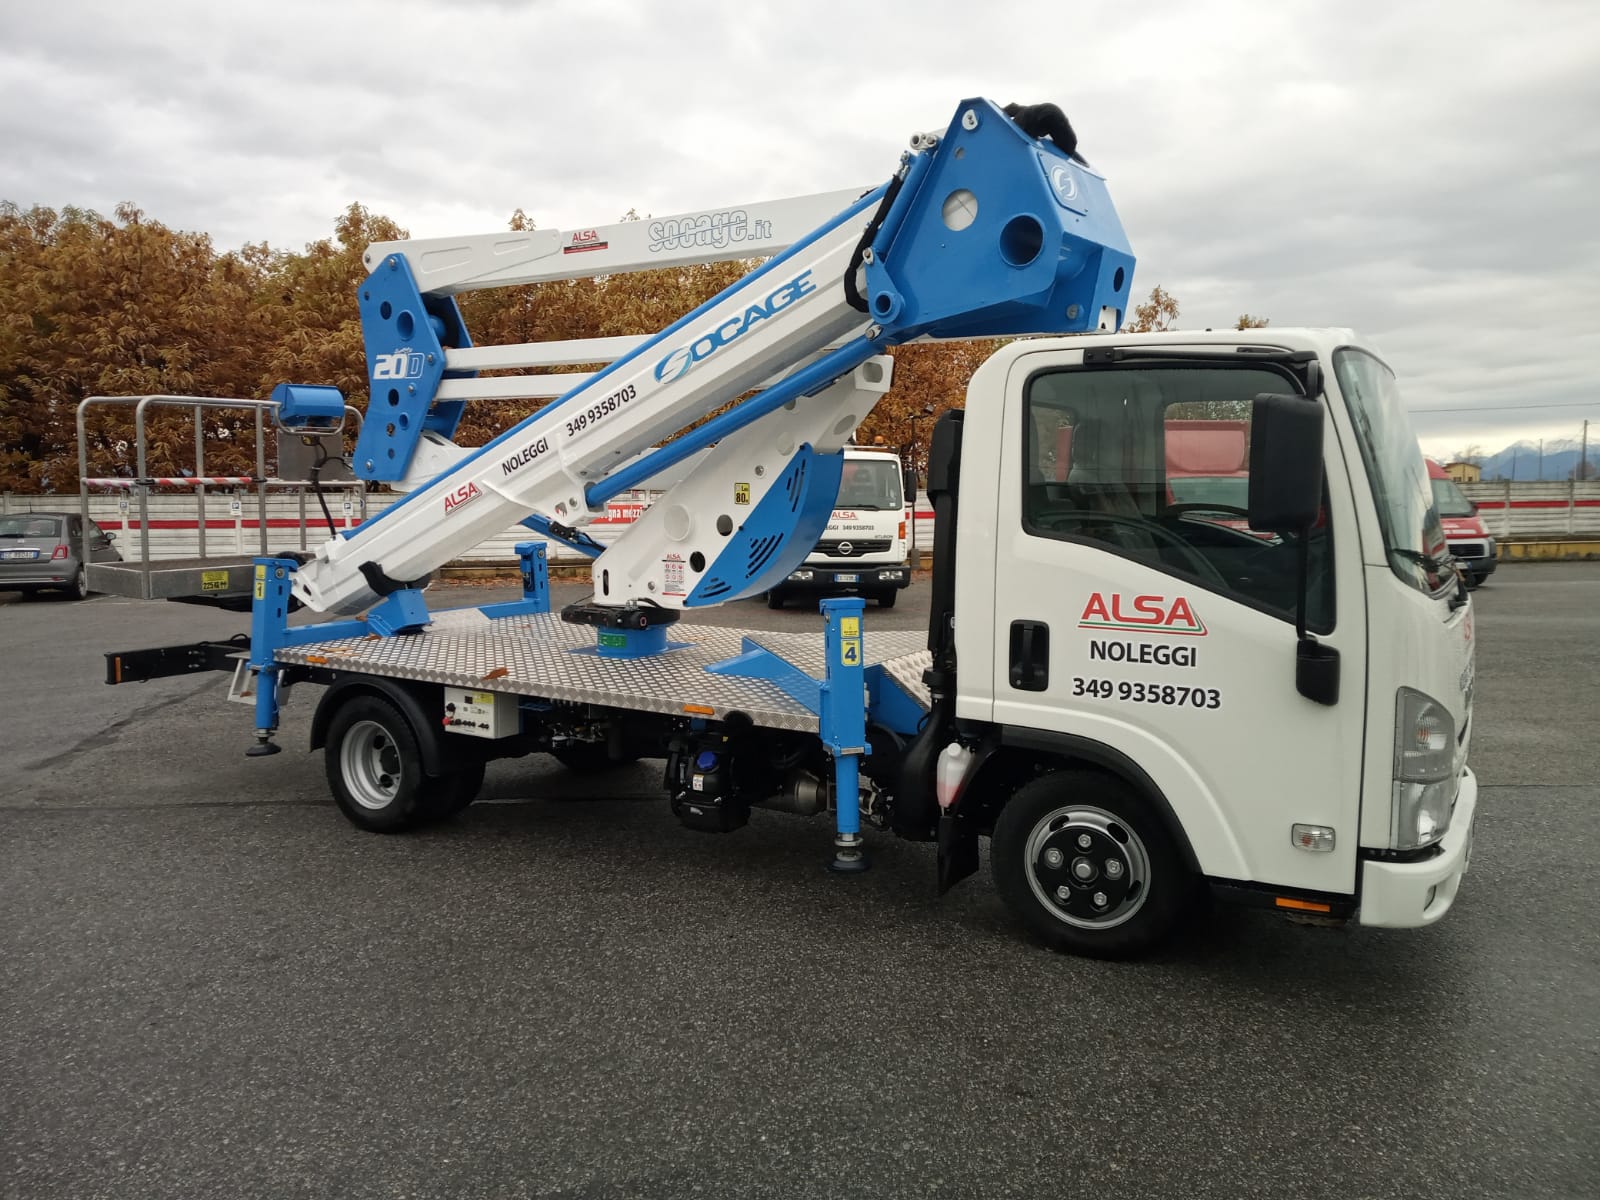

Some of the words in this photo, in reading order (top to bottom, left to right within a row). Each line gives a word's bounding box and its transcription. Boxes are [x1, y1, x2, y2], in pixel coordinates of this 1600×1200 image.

[572, 230, 597, 242] ALSA
[649, 210, 772, 252] socage.it
[654, 269, 817, 384] SOCAGE
[373, 353, 425, 379] 20D
[501, 437, 549, 476] NOLEGGI
[565, 415, 587, 437] 349
[587, 384, 637, 424] 9358703
[444, 482, 479, 512] ALSA
[832, 511, 857, 519] ALSA
[1081, 593, 1196, 627] ALSA
[845, 646, 857, 662] 4
[1090, 640, 1197, 667] NOLEGGI
[1072, 678, 1114, 698] 349
[1118, 682, 1221, 709] 9358703
